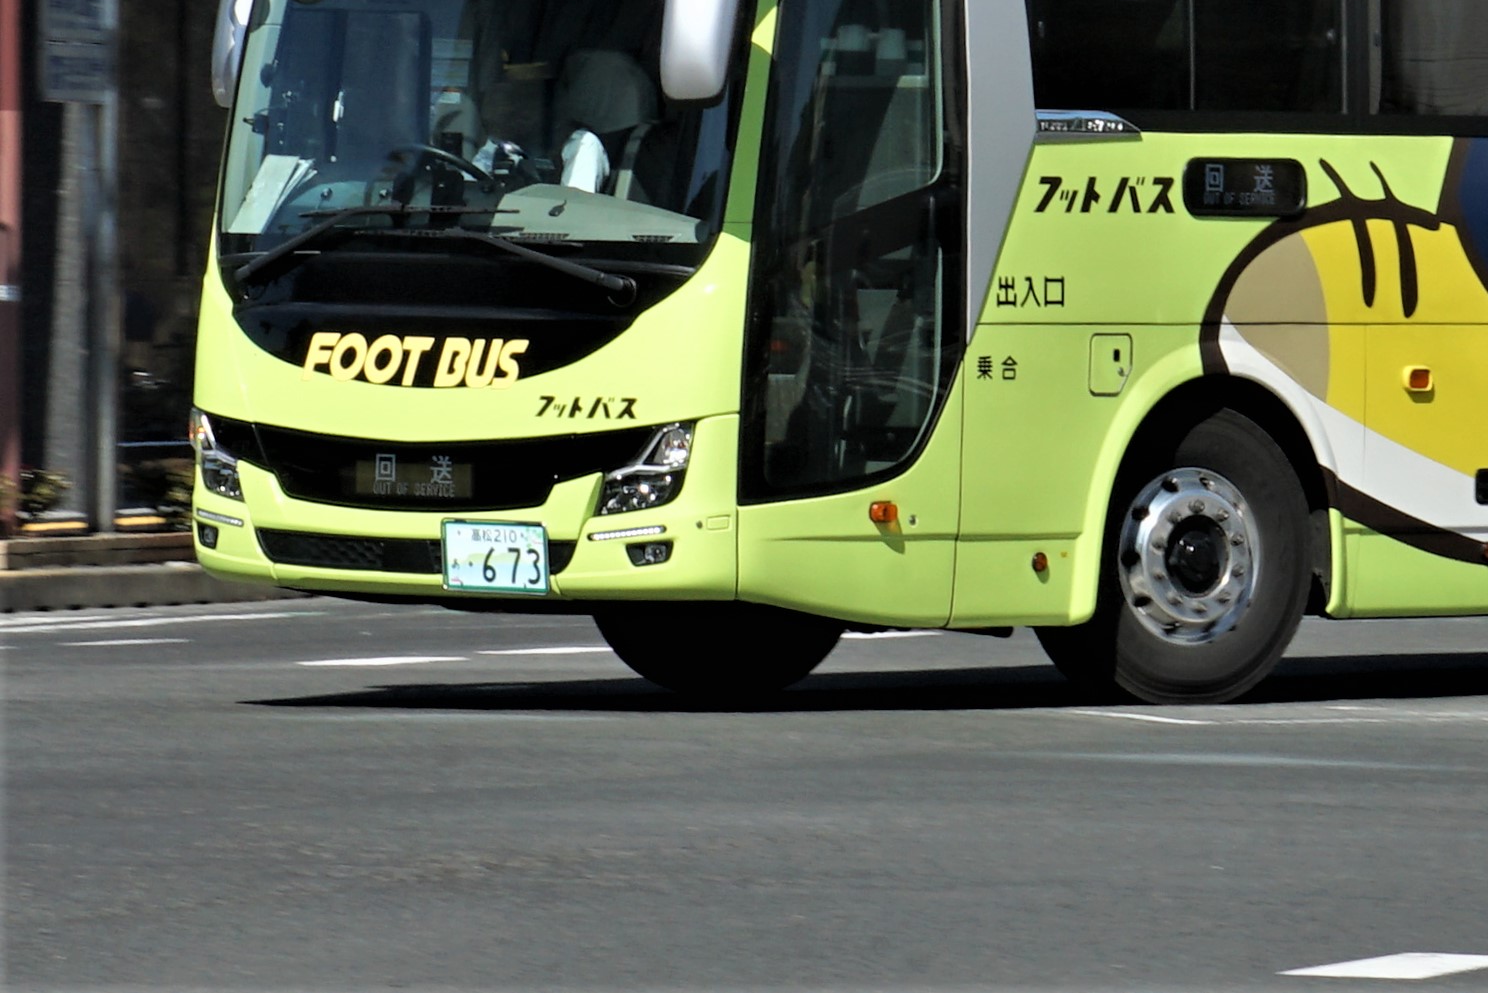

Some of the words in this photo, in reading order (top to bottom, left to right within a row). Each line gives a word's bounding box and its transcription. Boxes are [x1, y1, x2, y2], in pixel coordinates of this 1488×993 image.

[1034, 176, 1176, 214] フットバス
[996, 276, 1065, 308] 出入口
[302, 332, 436, 386] FOOT
[433, 336, 530, 388] BUS
[976, 355, 1018, 381] 乗合
[535, 395, 638, 419] フットバス
[373, 482, 391, 495] OUT
[396, 482, 409, 496] OF
[414, 482, 456, 497] SERVICE
